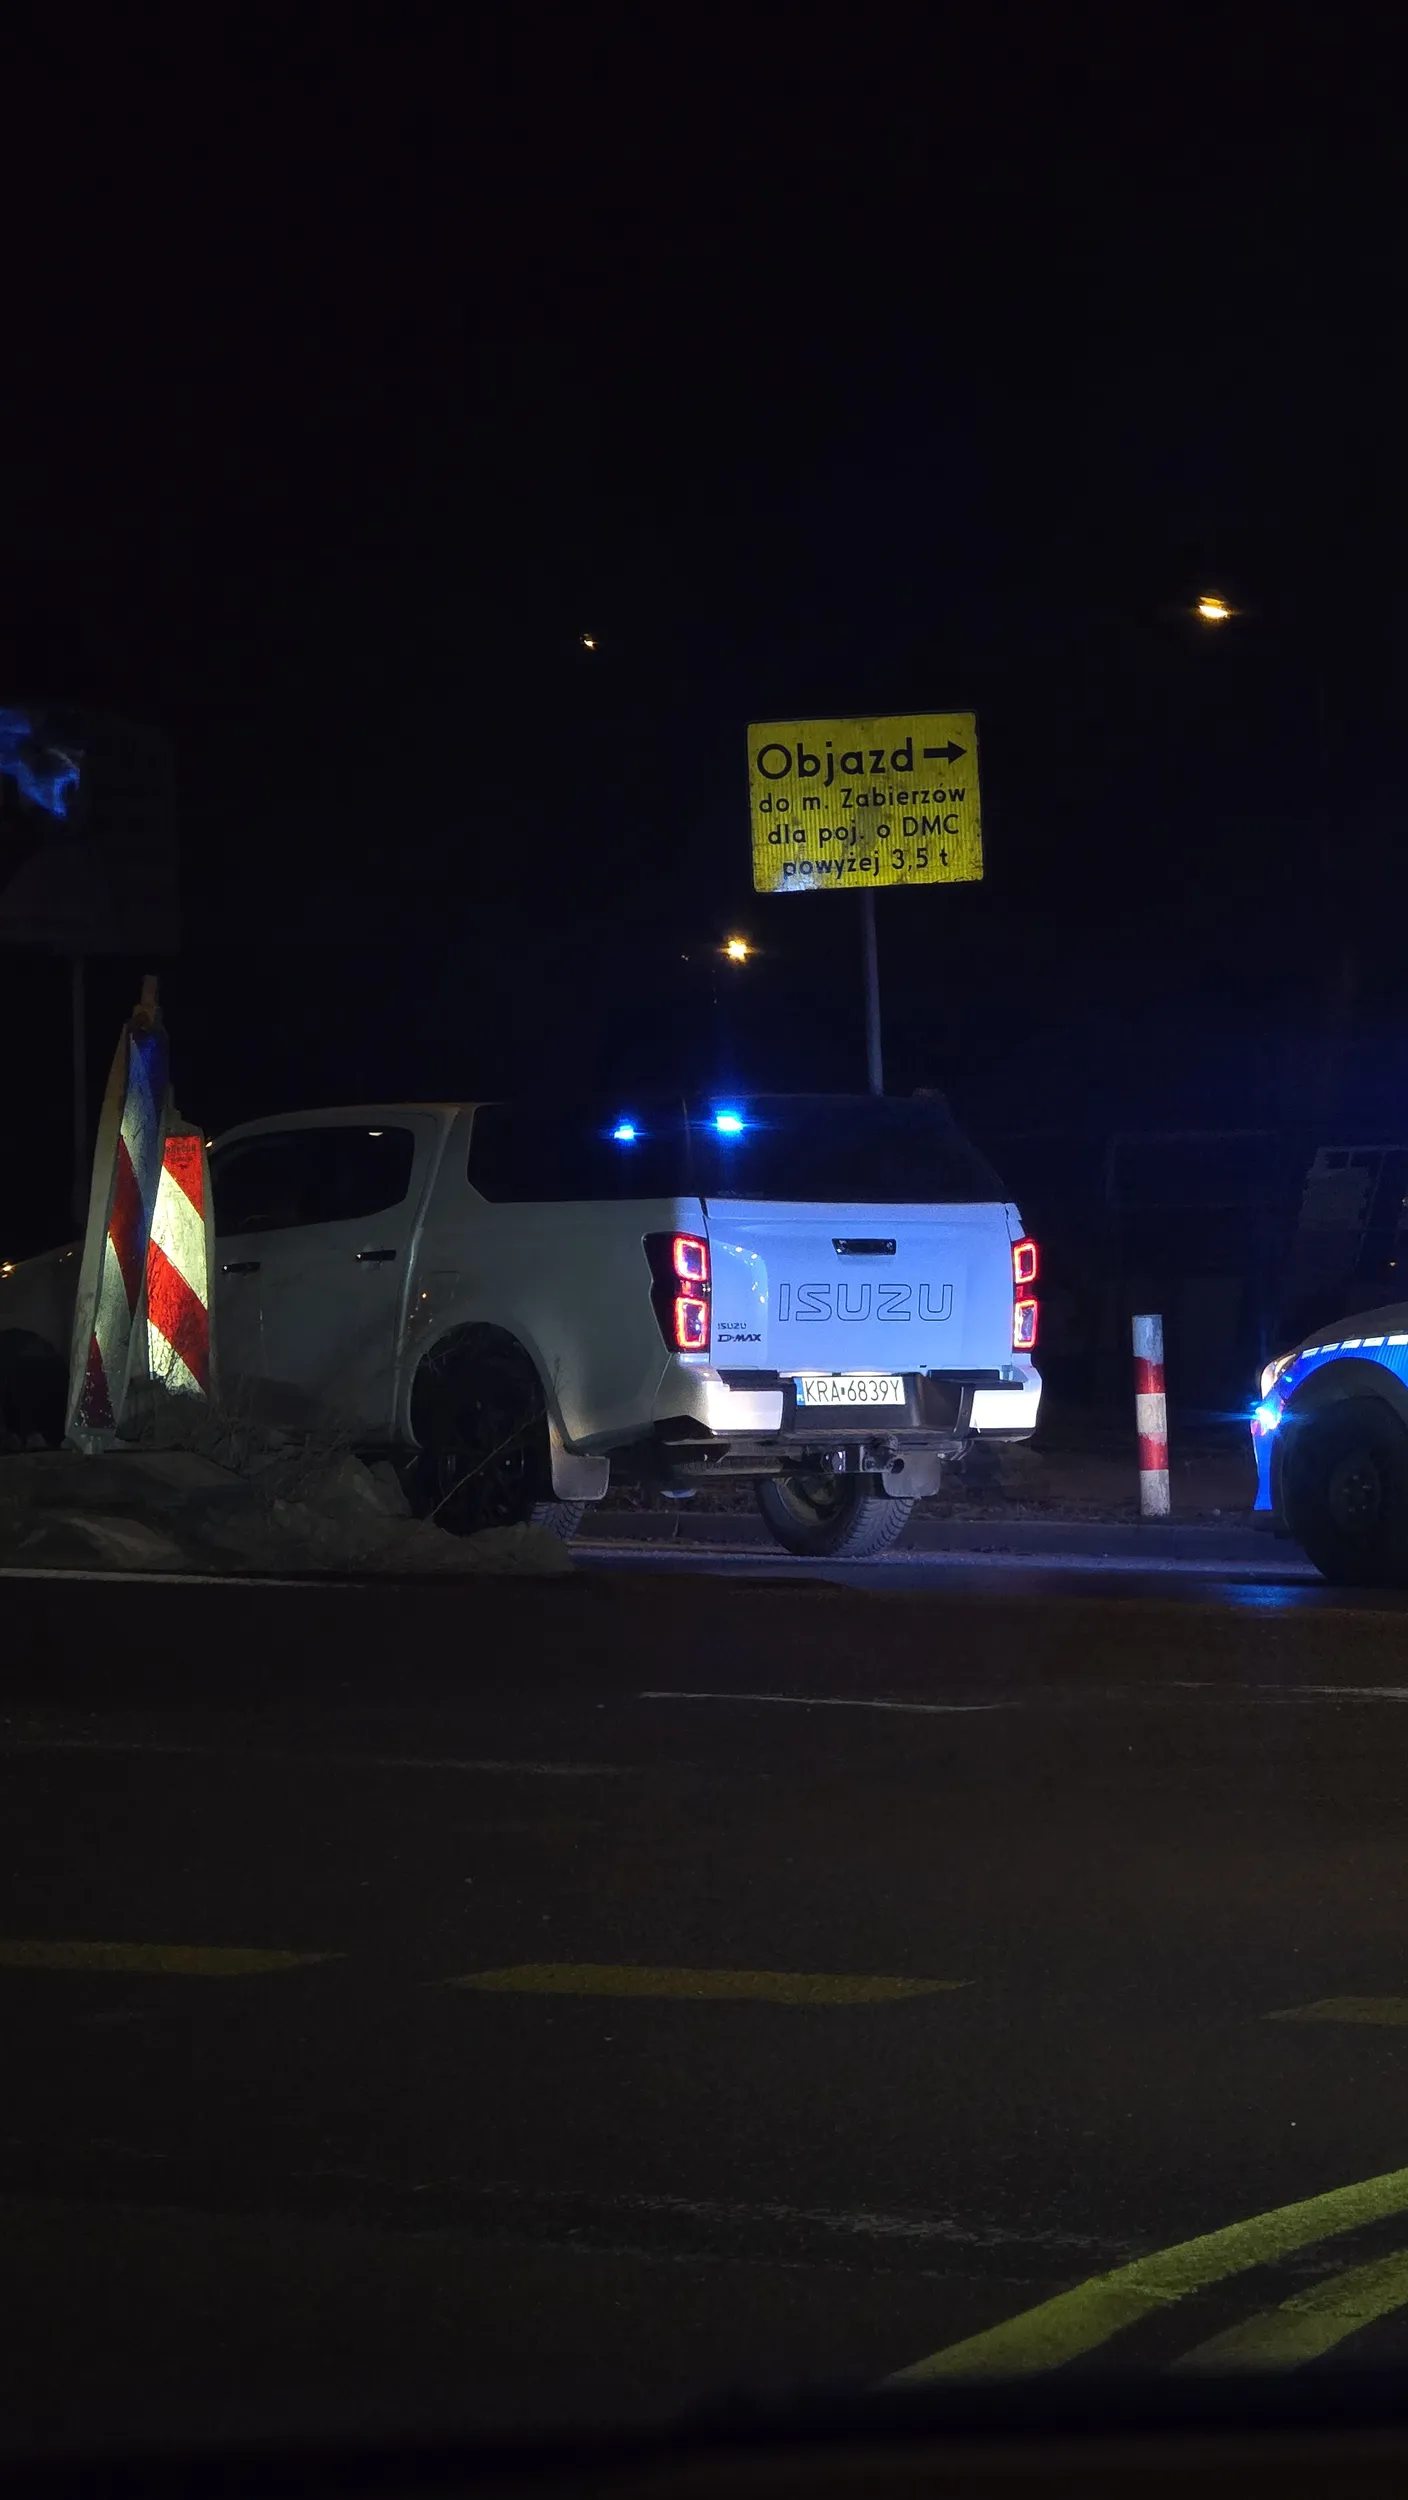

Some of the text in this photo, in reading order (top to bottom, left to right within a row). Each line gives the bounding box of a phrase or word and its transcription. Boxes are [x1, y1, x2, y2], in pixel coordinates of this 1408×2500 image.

[757, 737, 914, 788] Objazd
[759, 783, 966, 813] do m. Zabierzów
[768, 814, 960, 848] dla poj. o DMC
[782, 848, 949, 879] powyżej 3,5 t
[778, 1283, 954, 1322] ISUZU
[717, 1322, 747, 1330] ISUZU
[717, 1333, 762, 1343] D-MAX
